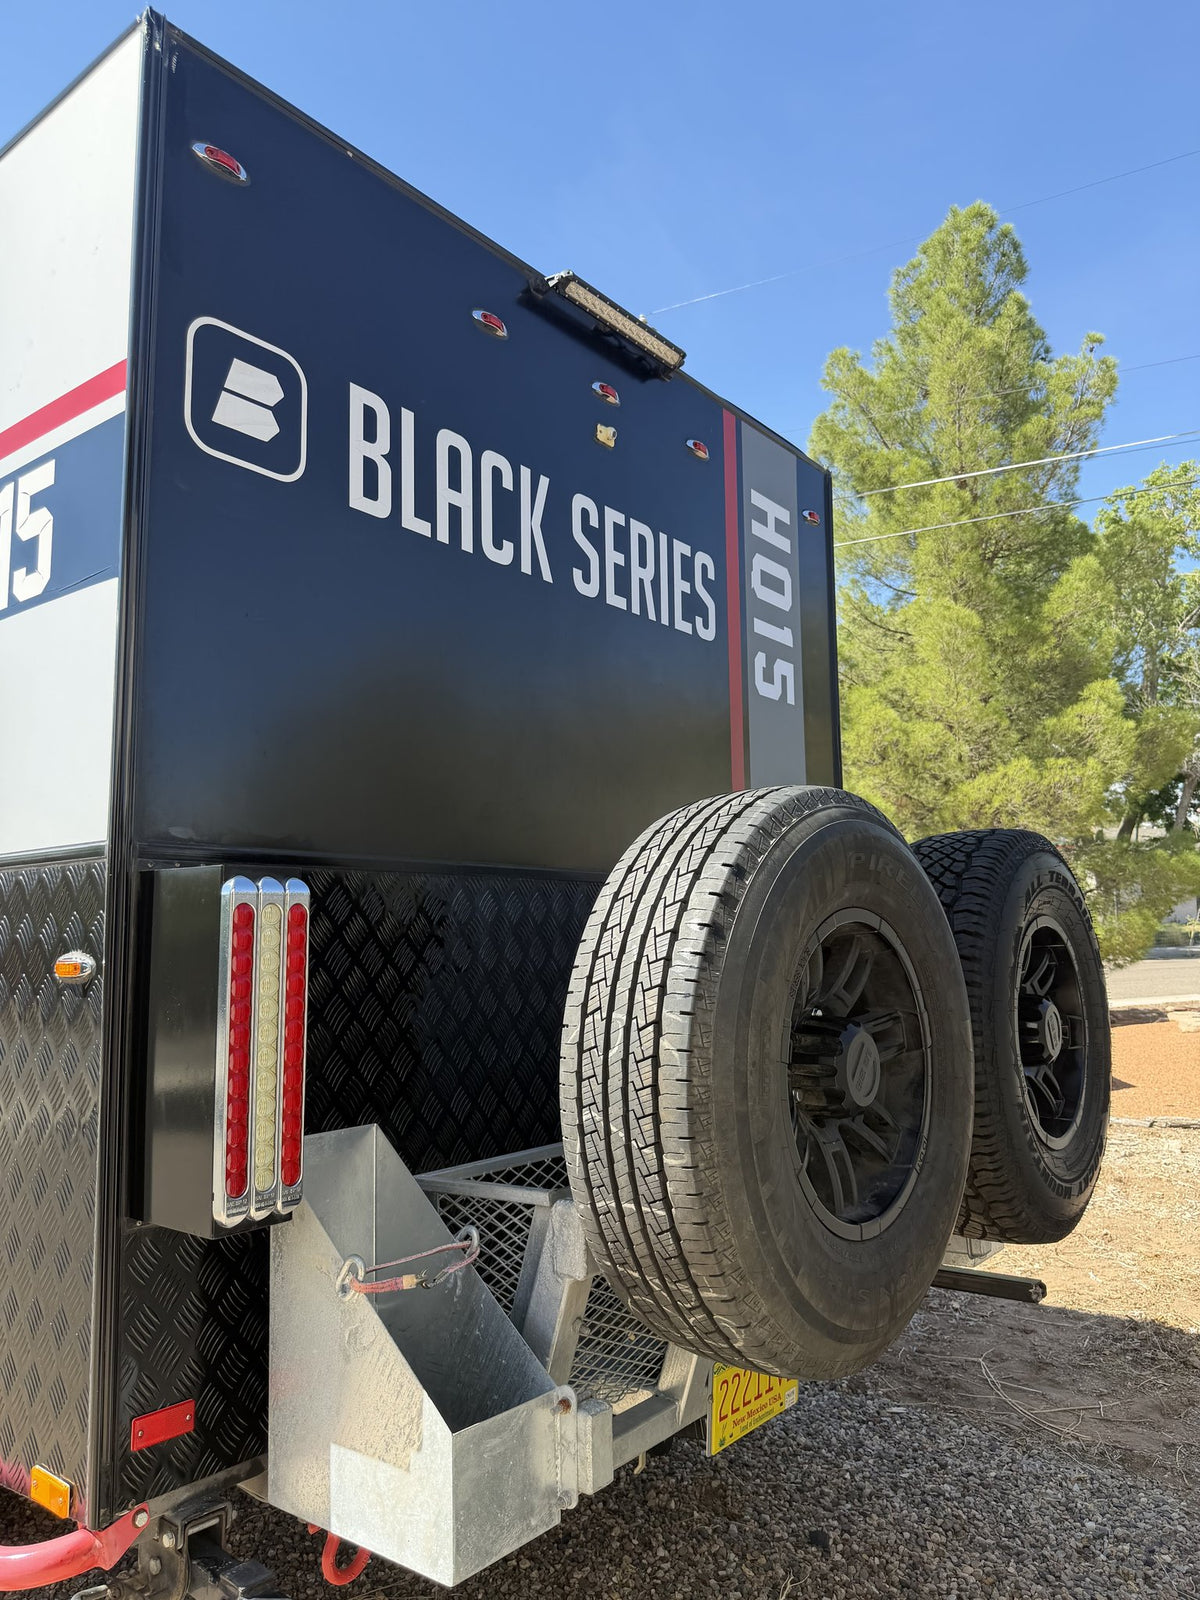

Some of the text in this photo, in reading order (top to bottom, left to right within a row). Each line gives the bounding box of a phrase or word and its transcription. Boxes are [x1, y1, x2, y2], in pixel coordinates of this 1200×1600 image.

[349, 382, 716, 642] BLACK SERIES
[750, 489, 796, 706] HQ15
[732, 1414, 746, 1429] New
[746, 1403, 768, 1420] Mexico
